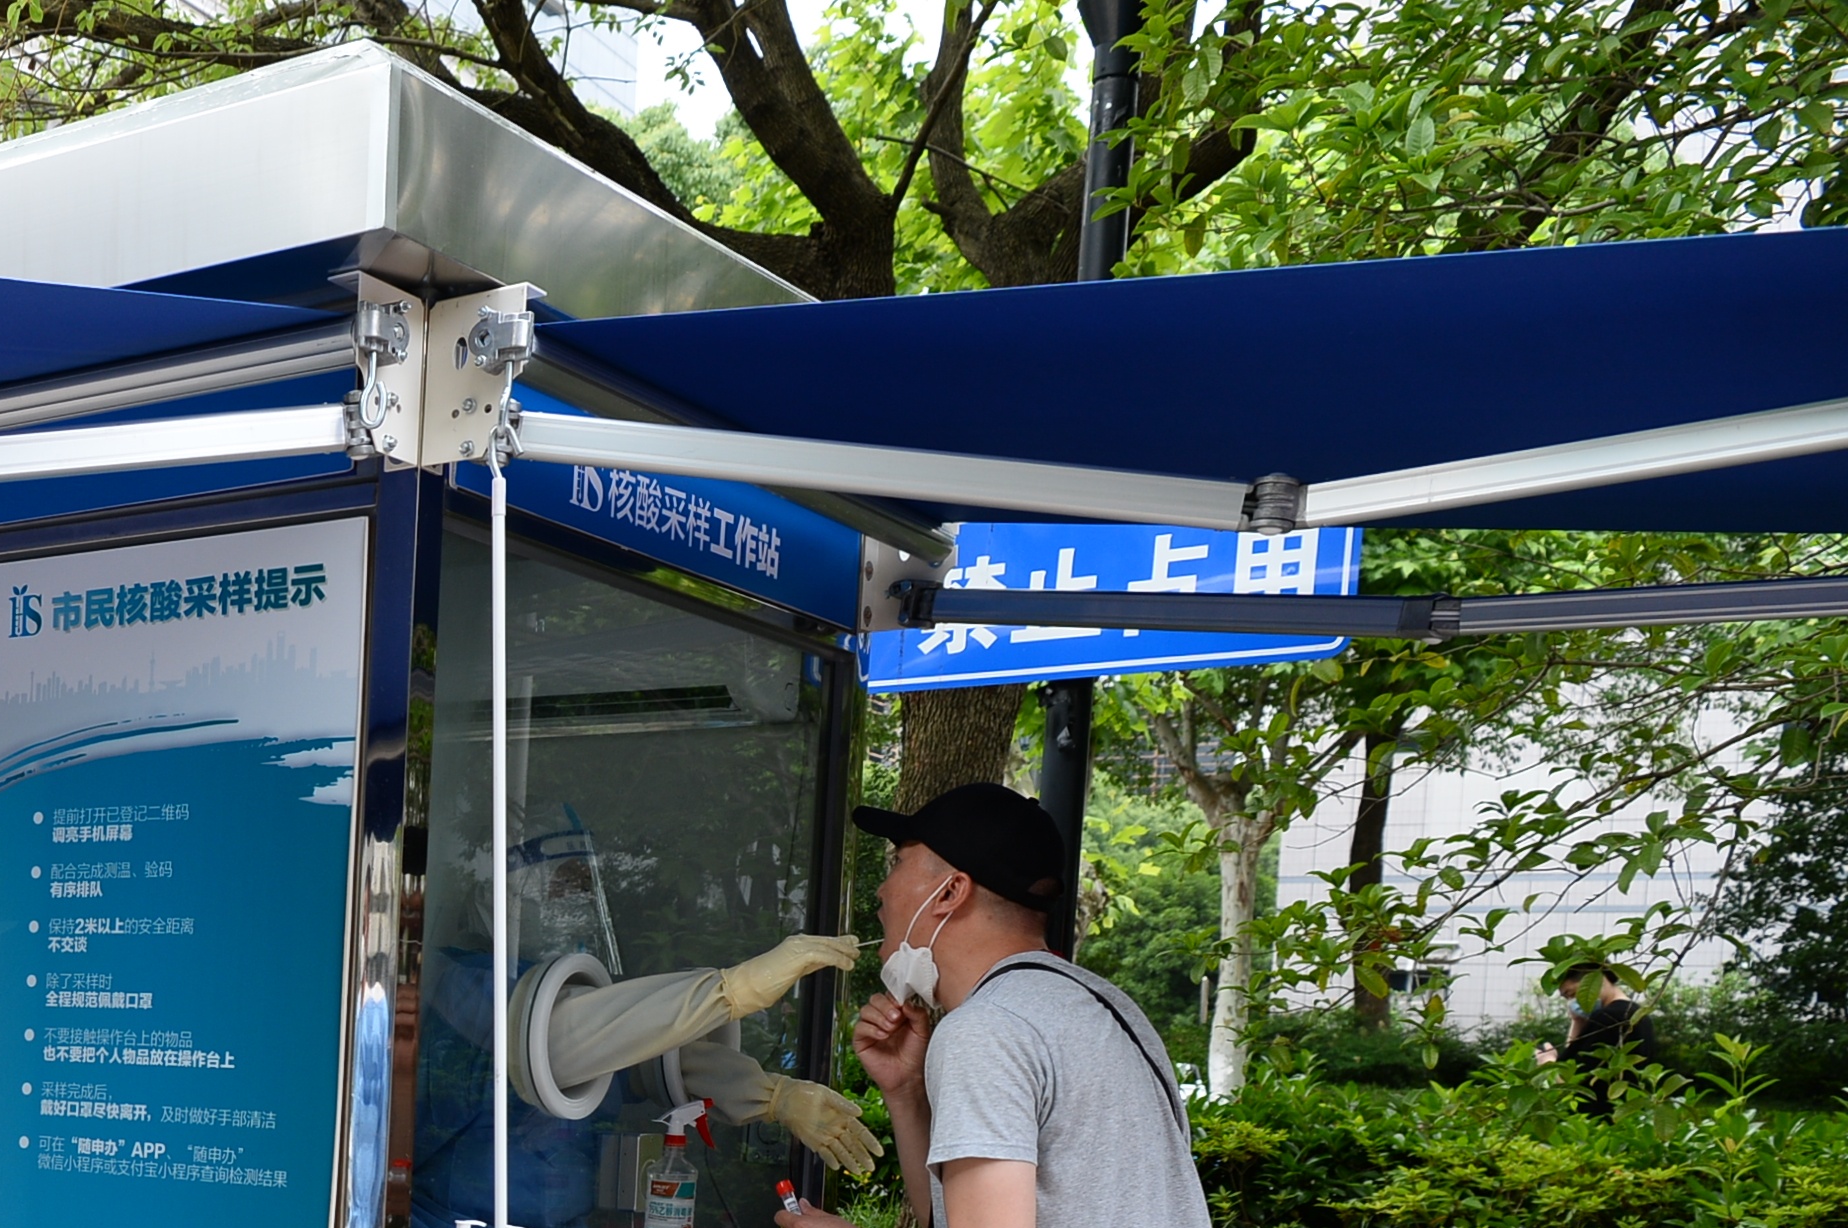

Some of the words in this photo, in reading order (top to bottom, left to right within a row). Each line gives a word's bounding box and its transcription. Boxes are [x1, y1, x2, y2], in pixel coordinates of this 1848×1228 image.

[608, 468, 783, 580] 核酸采样工作站
[51, 563, 328, 632] 市民核酸采样提示
[52, 804, 190, 826] 提前打开已登记二维码
[52, 825, 134, 844] 调亮手机屏幕
[50, 861, 173, 881] 配合完成测温、验码
[49, 880, 103, 899] 有序排队
[48, 917, 195, 936] 保持2米以上的安全距离
[47, 936, 88, 954] 不交谈
[45, 973, 114, 990] 除了采样时
[45, 991, 154, 1010] 全程规范佩戴口罩
[43, 1028, 194, 1049] 不要接触操作台上的物品
[43, 1046, 235, 1070] 也不要把个人物品放在操作台上
[37, 1153, 288, 1189] 微信小程序或支付宝小程序查询检测结果
